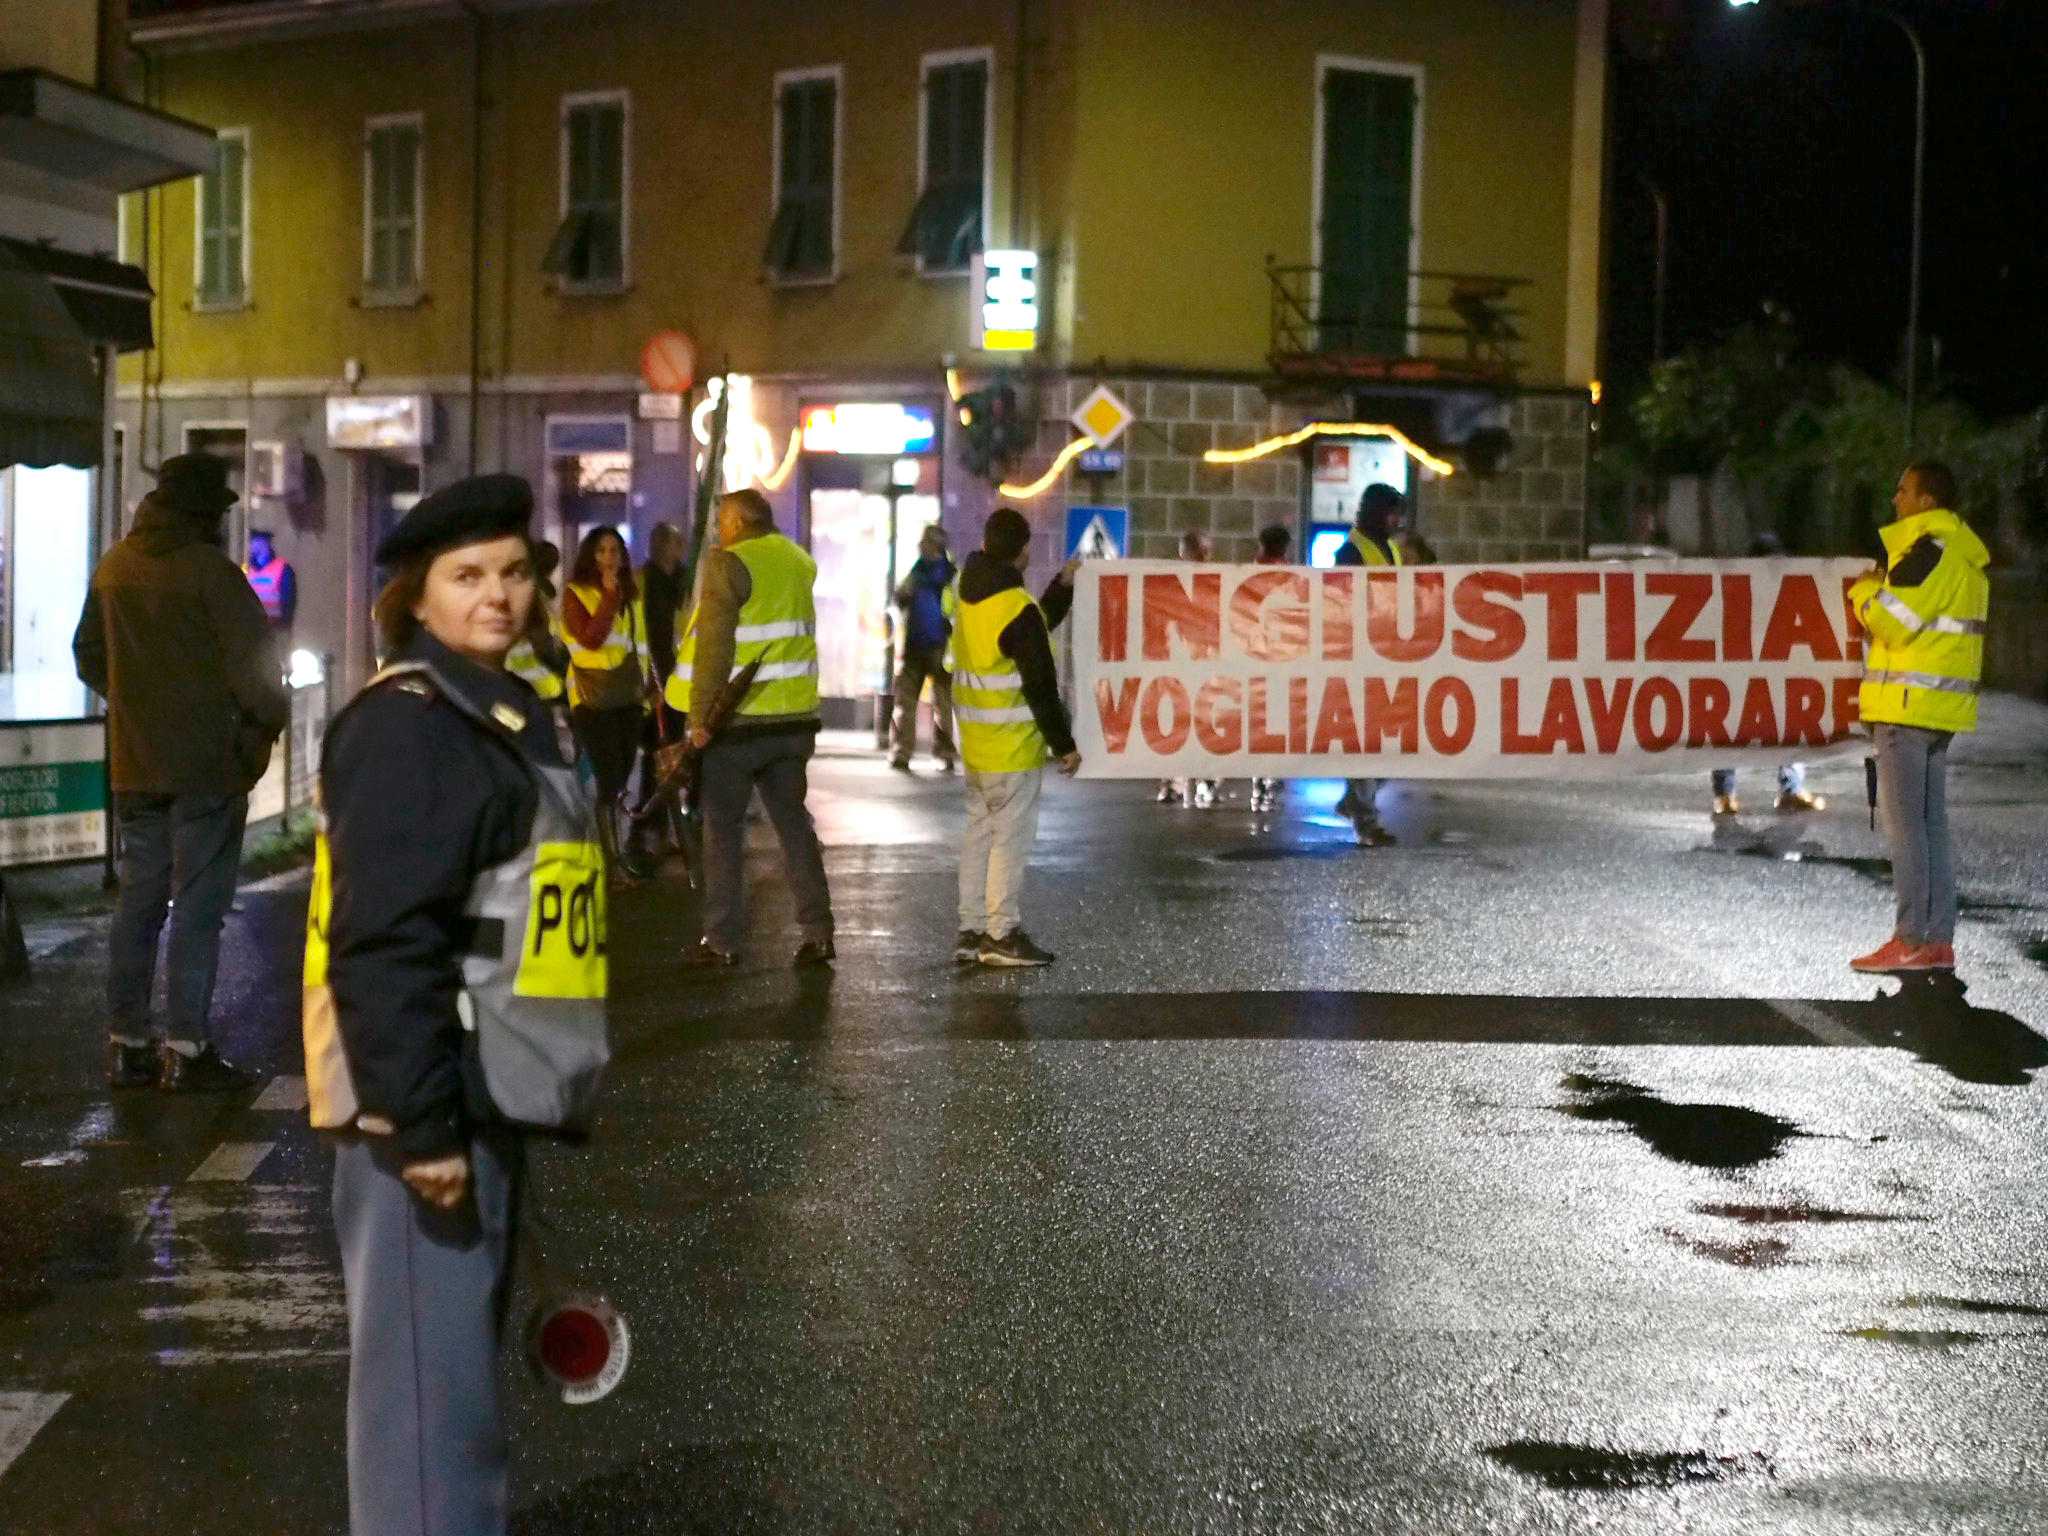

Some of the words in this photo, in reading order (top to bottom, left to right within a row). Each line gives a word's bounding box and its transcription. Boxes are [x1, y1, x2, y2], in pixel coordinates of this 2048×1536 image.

[1098, 571, 1864, 662] INGIUSTIZIA!
[1095, 676, 1477, 755] VOGLIAMO
[1499, 676, 1862, 755] LAVORARE
